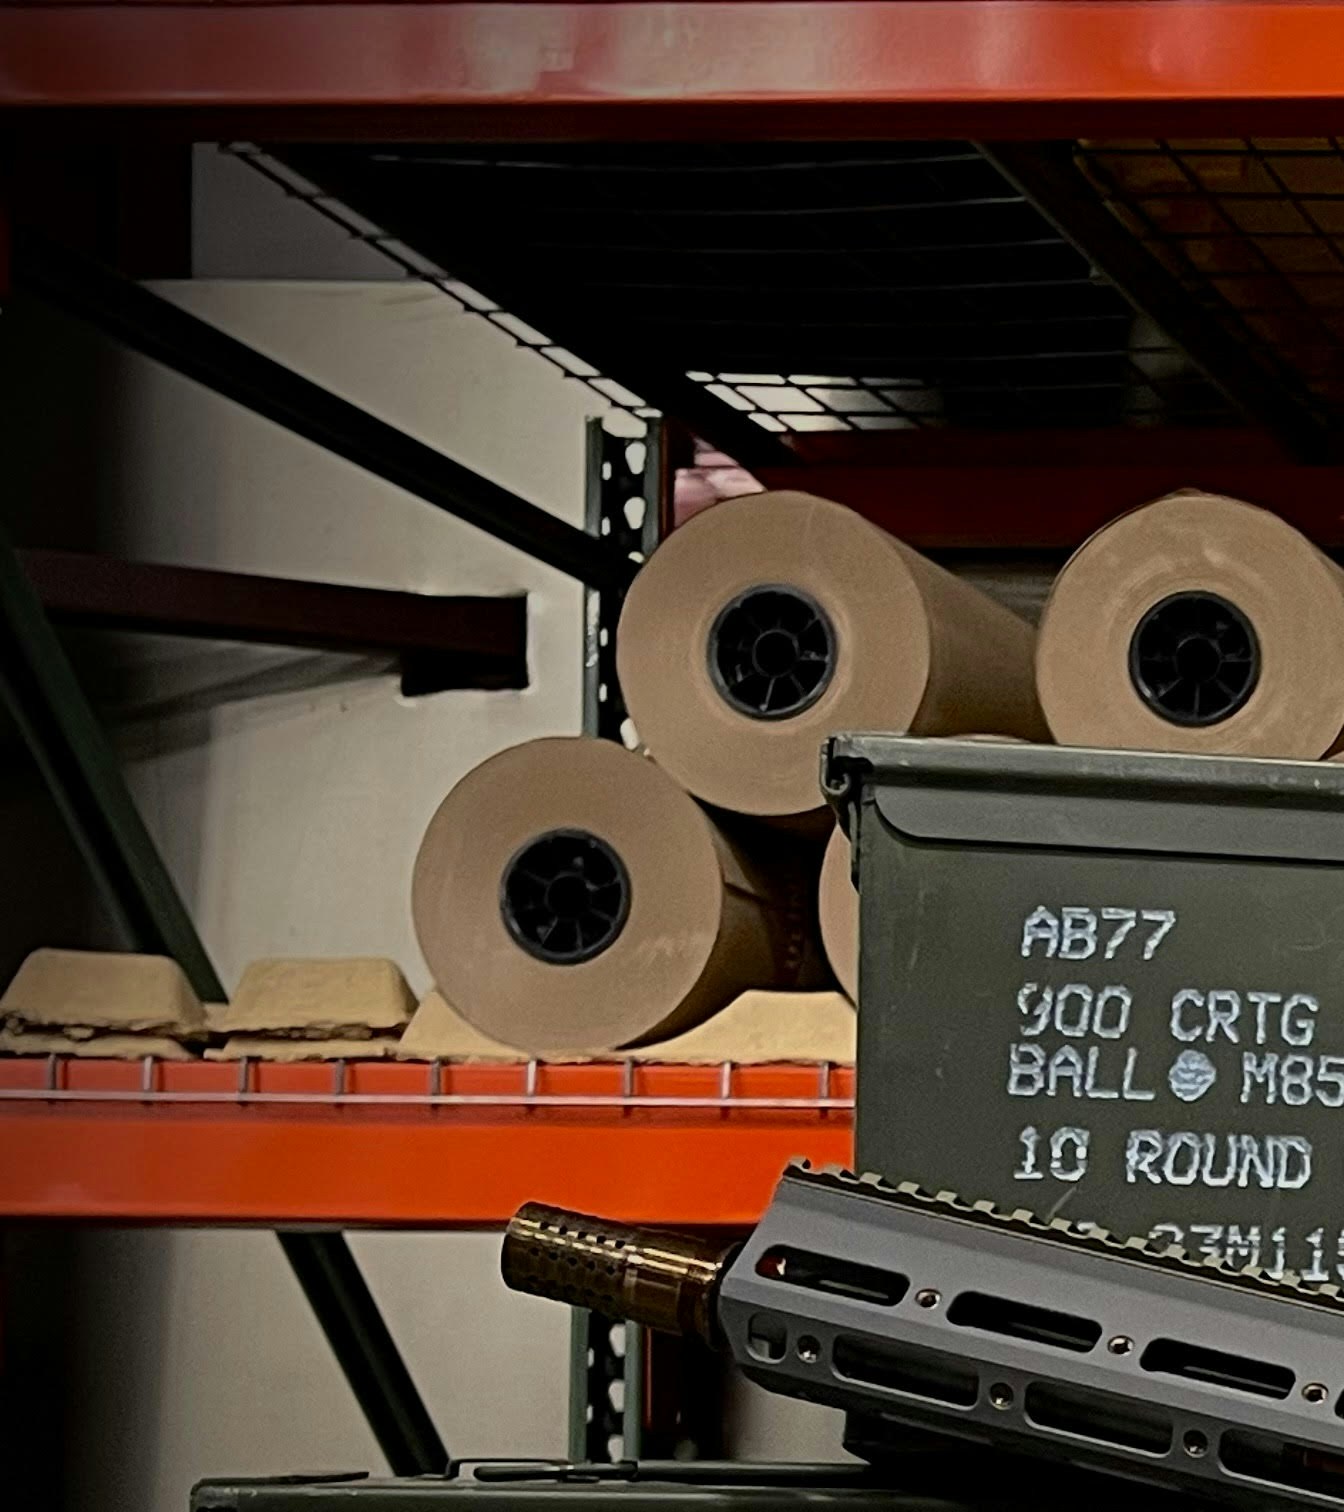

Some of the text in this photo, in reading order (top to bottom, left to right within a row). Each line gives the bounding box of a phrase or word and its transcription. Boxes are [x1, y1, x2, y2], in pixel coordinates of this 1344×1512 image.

[1021, 905, 1176, 960] AB77
[1017, 982, 1132, 1039] 900
[1170, 988, 1319, 1046] CRTG
[1007, 1043, 1156, 1101] BALL
[1013, 1126, 1090, 1182] 10
[1125, 1130, 1312, 1189] ROUND
